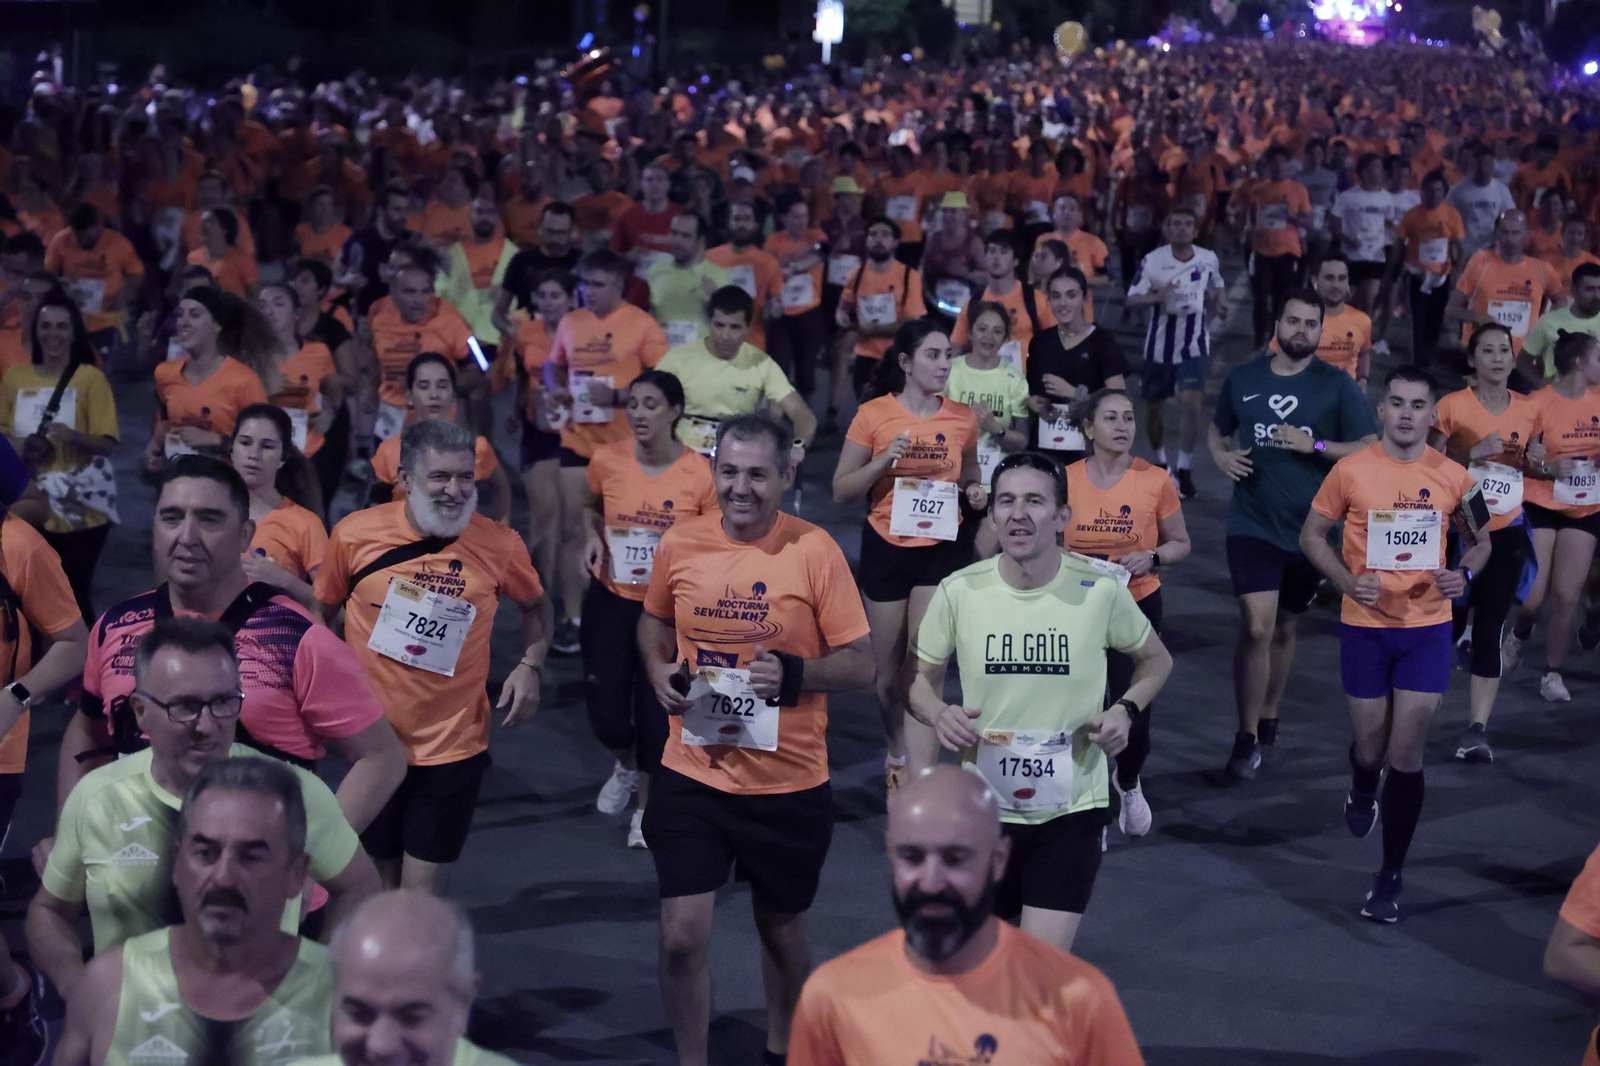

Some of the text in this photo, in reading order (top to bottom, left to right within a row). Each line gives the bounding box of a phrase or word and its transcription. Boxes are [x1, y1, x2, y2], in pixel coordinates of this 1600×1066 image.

[1482, 478, 1511, 495] 6720
[1568, 475, 1597, 488] 10839
[912, 498, 945, 515] 7627
[1393, 502, 1434, 511] NOCTURNA
[1076, 524, 1111, 533] SEVILLA
[1093, 518, 1134, 526] NOCTURNA
[1385, 530, 1428, 546] 15024
[414, 571, 467, 588] NOCTURNA
[716, 598, 770, 612] NOCTURNA
[693, 606, 740, 621] SEVILLA
[405, 611, 448, 641] 7824
[985, 627, 1070, 663] C.A. GAÏA
[988, 665, 1066, 673] CARMONA
[710, 695, 755, 717] 7622
[998, 757, 1055, 777] 17534
